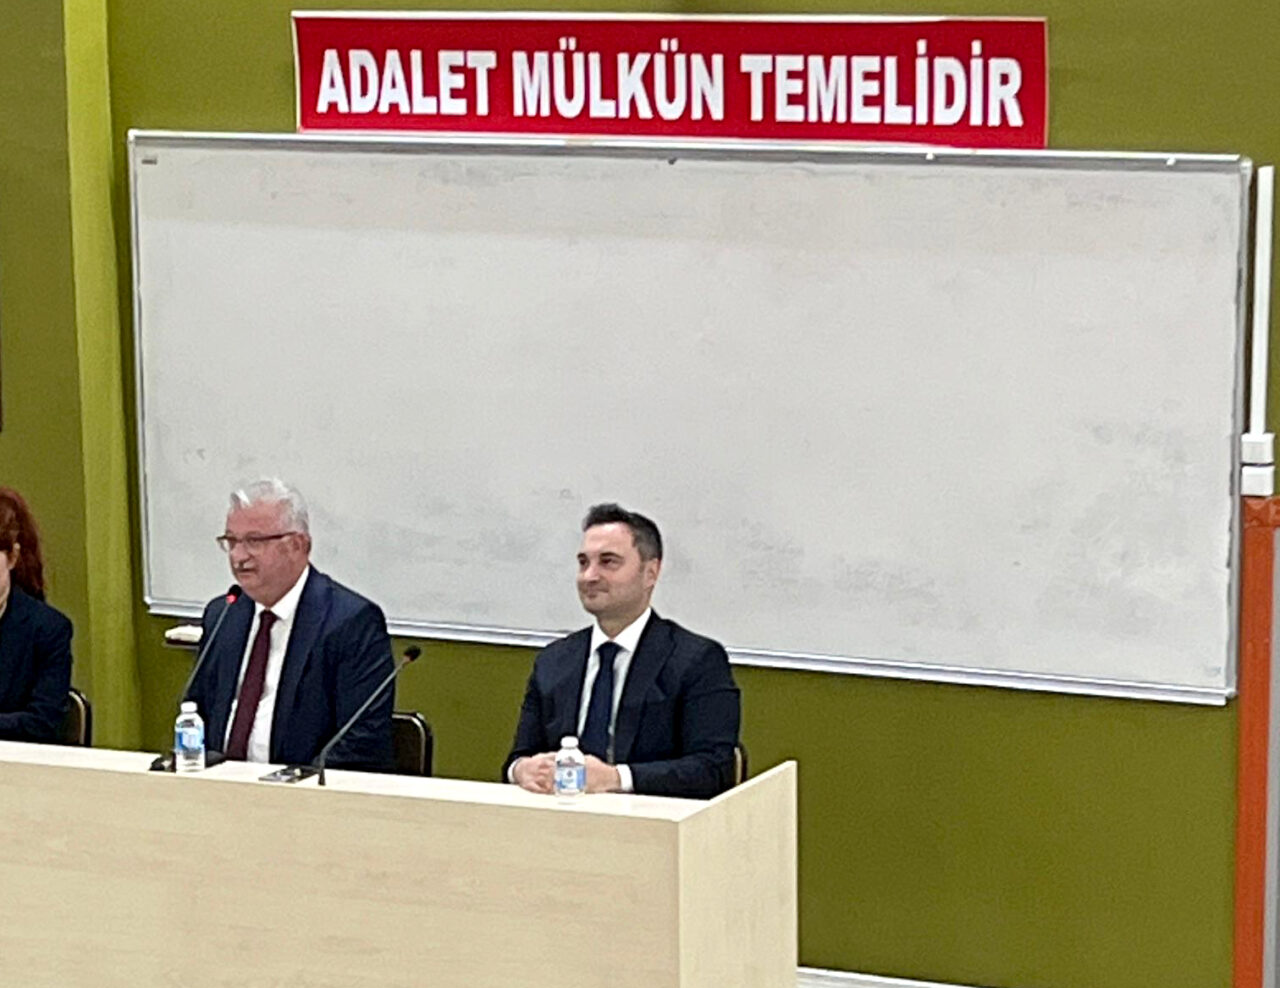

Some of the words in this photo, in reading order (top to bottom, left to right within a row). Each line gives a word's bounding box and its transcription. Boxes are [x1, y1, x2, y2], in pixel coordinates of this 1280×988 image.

[317, 49, 496, 115] ADALET
[513, 38, 723, 120] MÜLKÜN
[741, 40, 1023, 126] TEMELİDİR
